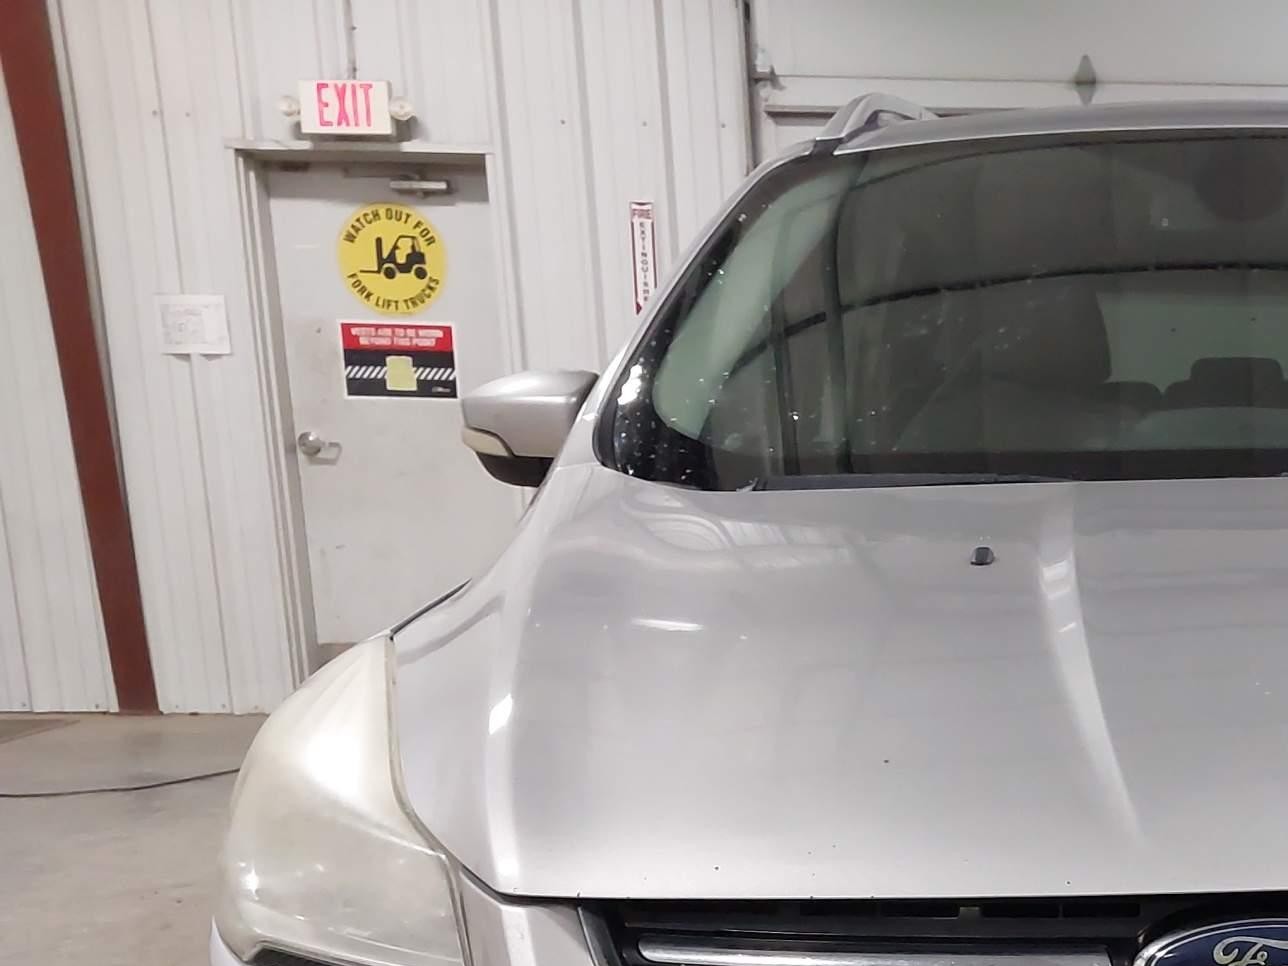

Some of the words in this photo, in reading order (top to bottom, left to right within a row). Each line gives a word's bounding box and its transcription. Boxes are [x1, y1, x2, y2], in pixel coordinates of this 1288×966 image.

[316, 83, 373, 127] EXIT
[343, 208, 381, 244] WATCH
[385, 207, 412, 224] OUT
[412, 219, 436, 246] FOR
[639, 221, 650, 303] EXTINGUISHE
[346, 272, 374, 303] FORK
[375, 295, 399, 312] LIFT
[403, 276, 440, 311] TRUCKS
